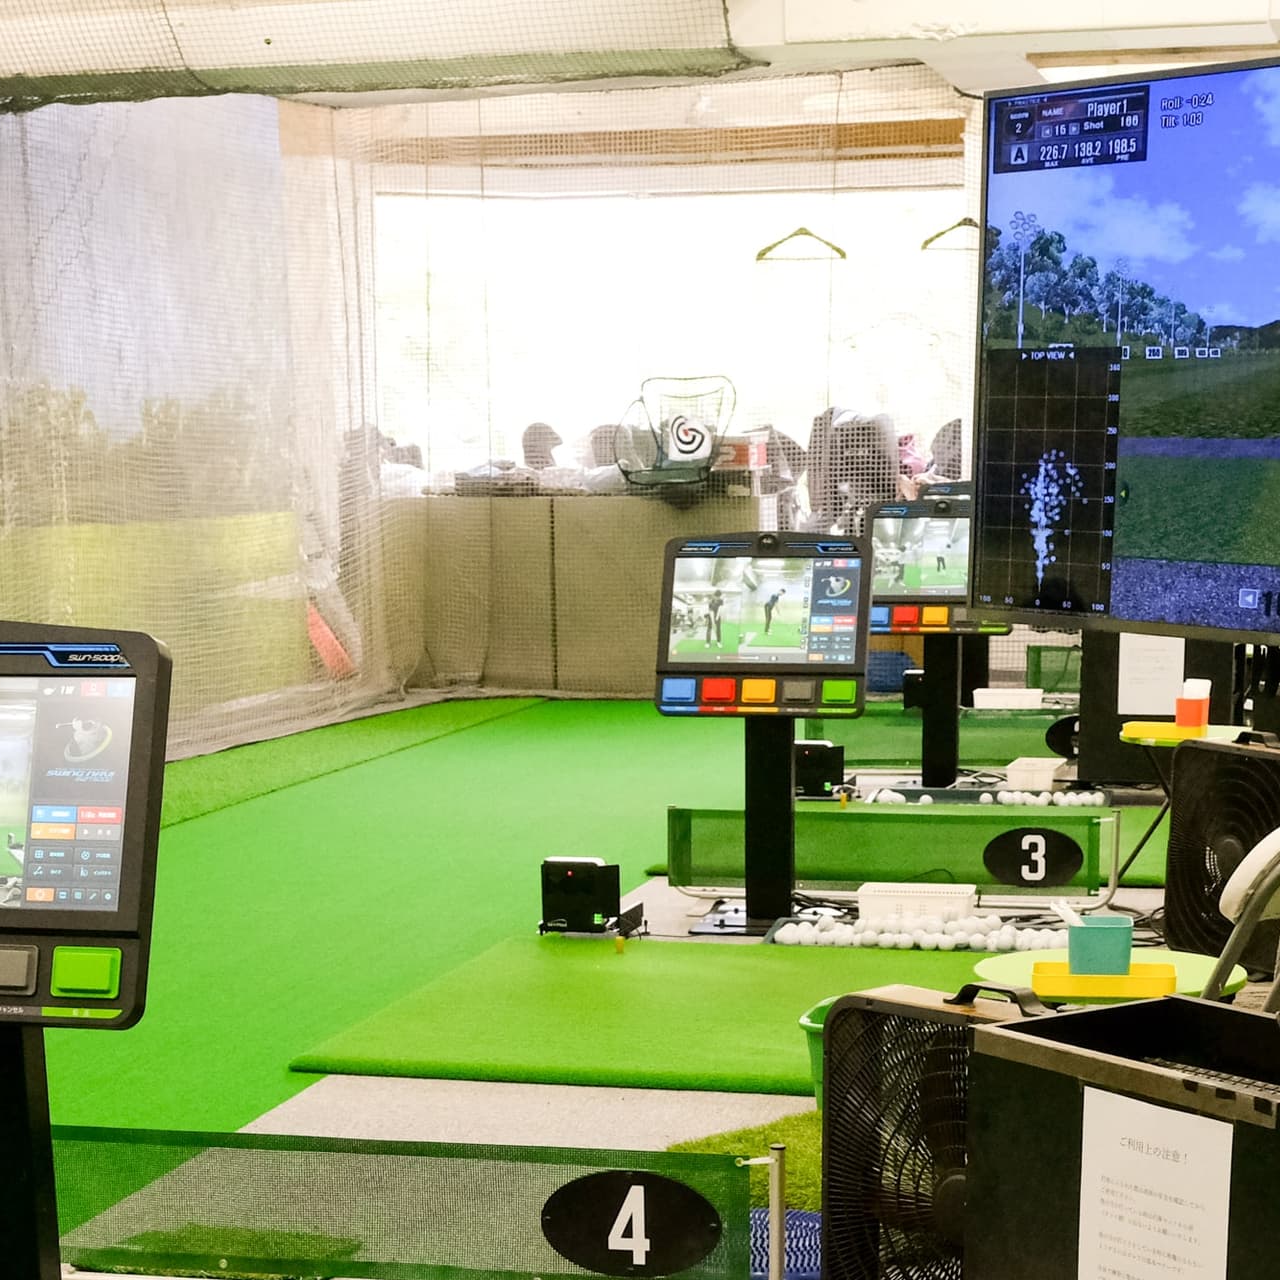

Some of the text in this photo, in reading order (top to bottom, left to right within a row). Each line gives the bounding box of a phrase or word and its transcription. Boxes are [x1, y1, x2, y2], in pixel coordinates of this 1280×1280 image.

[1042, 107, 1064, 117] NAME
[1087, 99, 1127, 117] Player1
[1015, 123, 1022, 134] 2
[1083, 120, 1104, 131] Shot
[1013, 146, 1025, 162] A
[1040, 138, 1137, 161] 226.7 138.2 198.5
[1030, 351, 1066, 361] TOP VIEW
[1021, 834, 1046, 881] 3
[608, 1184, 651, 1266] 4
